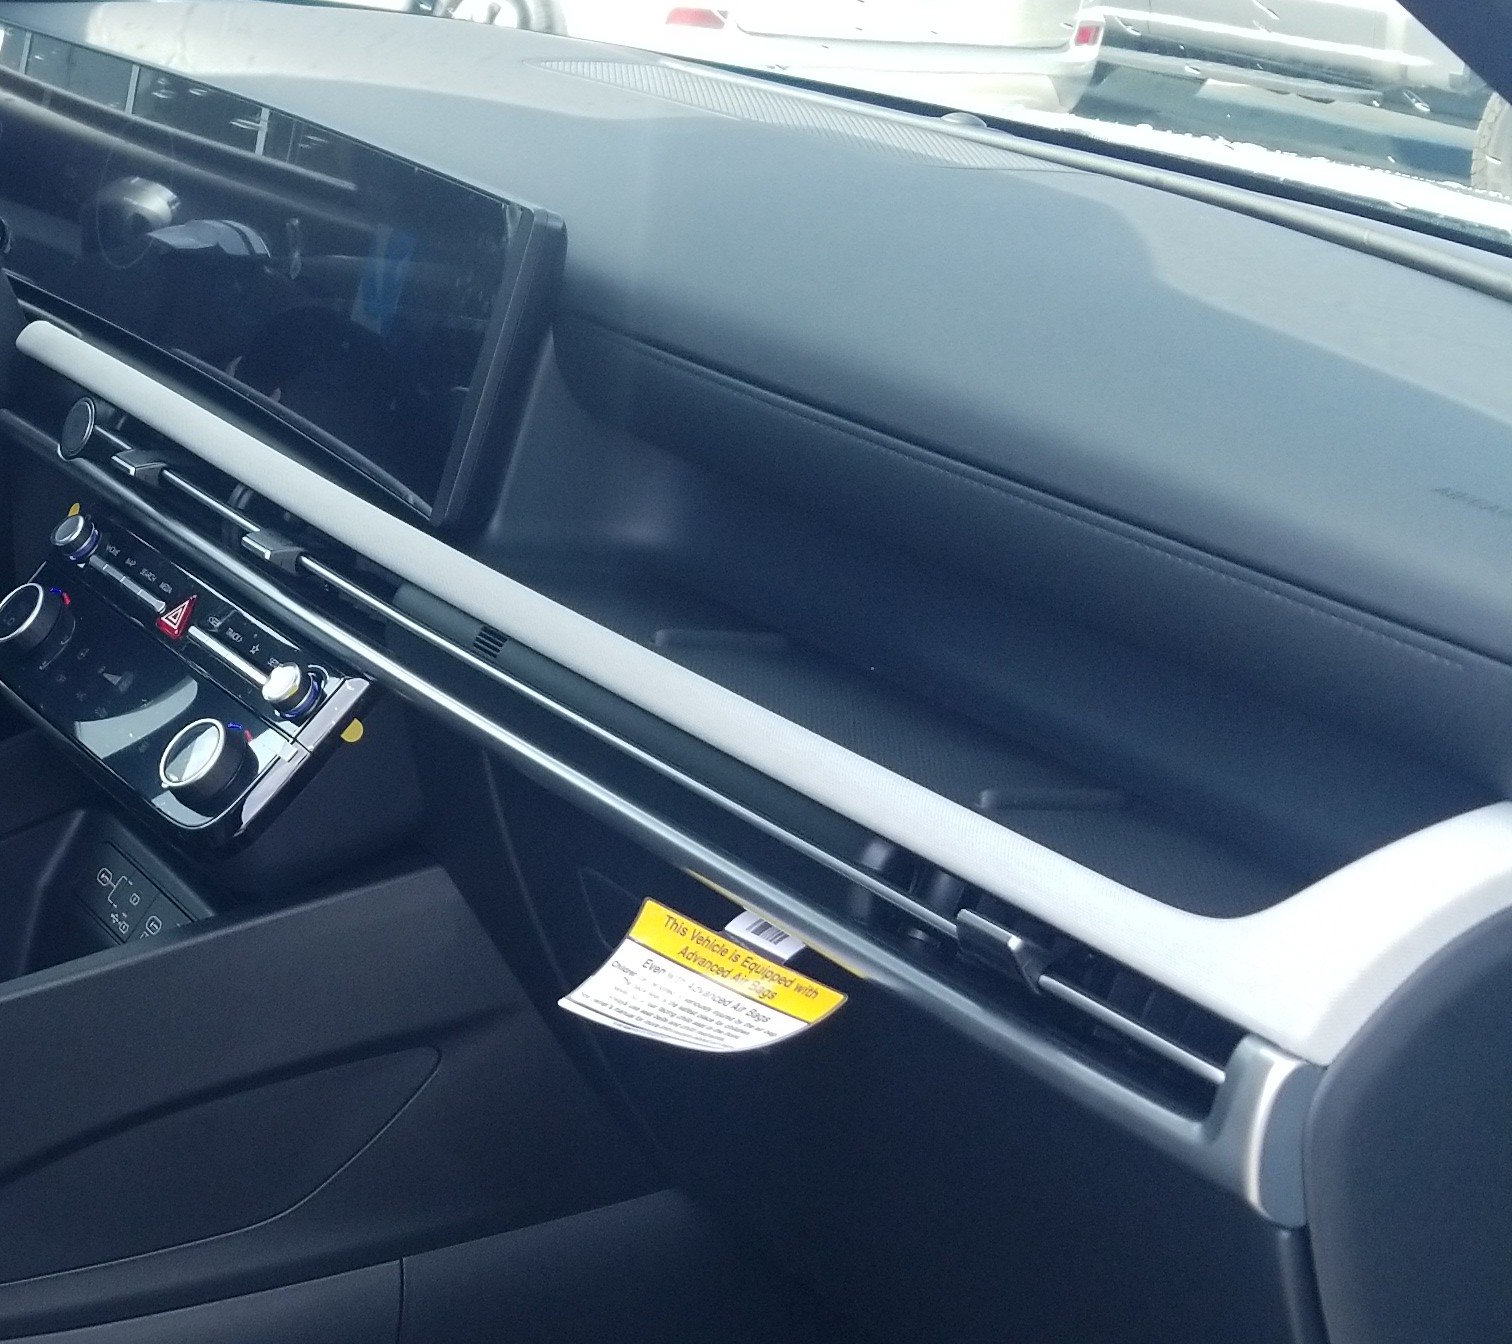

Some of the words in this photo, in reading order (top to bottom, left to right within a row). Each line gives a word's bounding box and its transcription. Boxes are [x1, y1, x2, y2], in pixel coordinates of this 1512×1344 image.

[664, 914, 688, 937] This
[689, 928, 729, 957] Vehicle
[729, 949, 741, 963] is
[741, 956, 794, 988] Equipped
[794, 978, 819, 999] with
[677, 946, 734, 979] Advanced
[732, 972, 750, 985] Air
[749, 980, 778, 1000] Bags
[642, 958, 666, 975] Even
[746, 1008, 771, 1023] Bags
